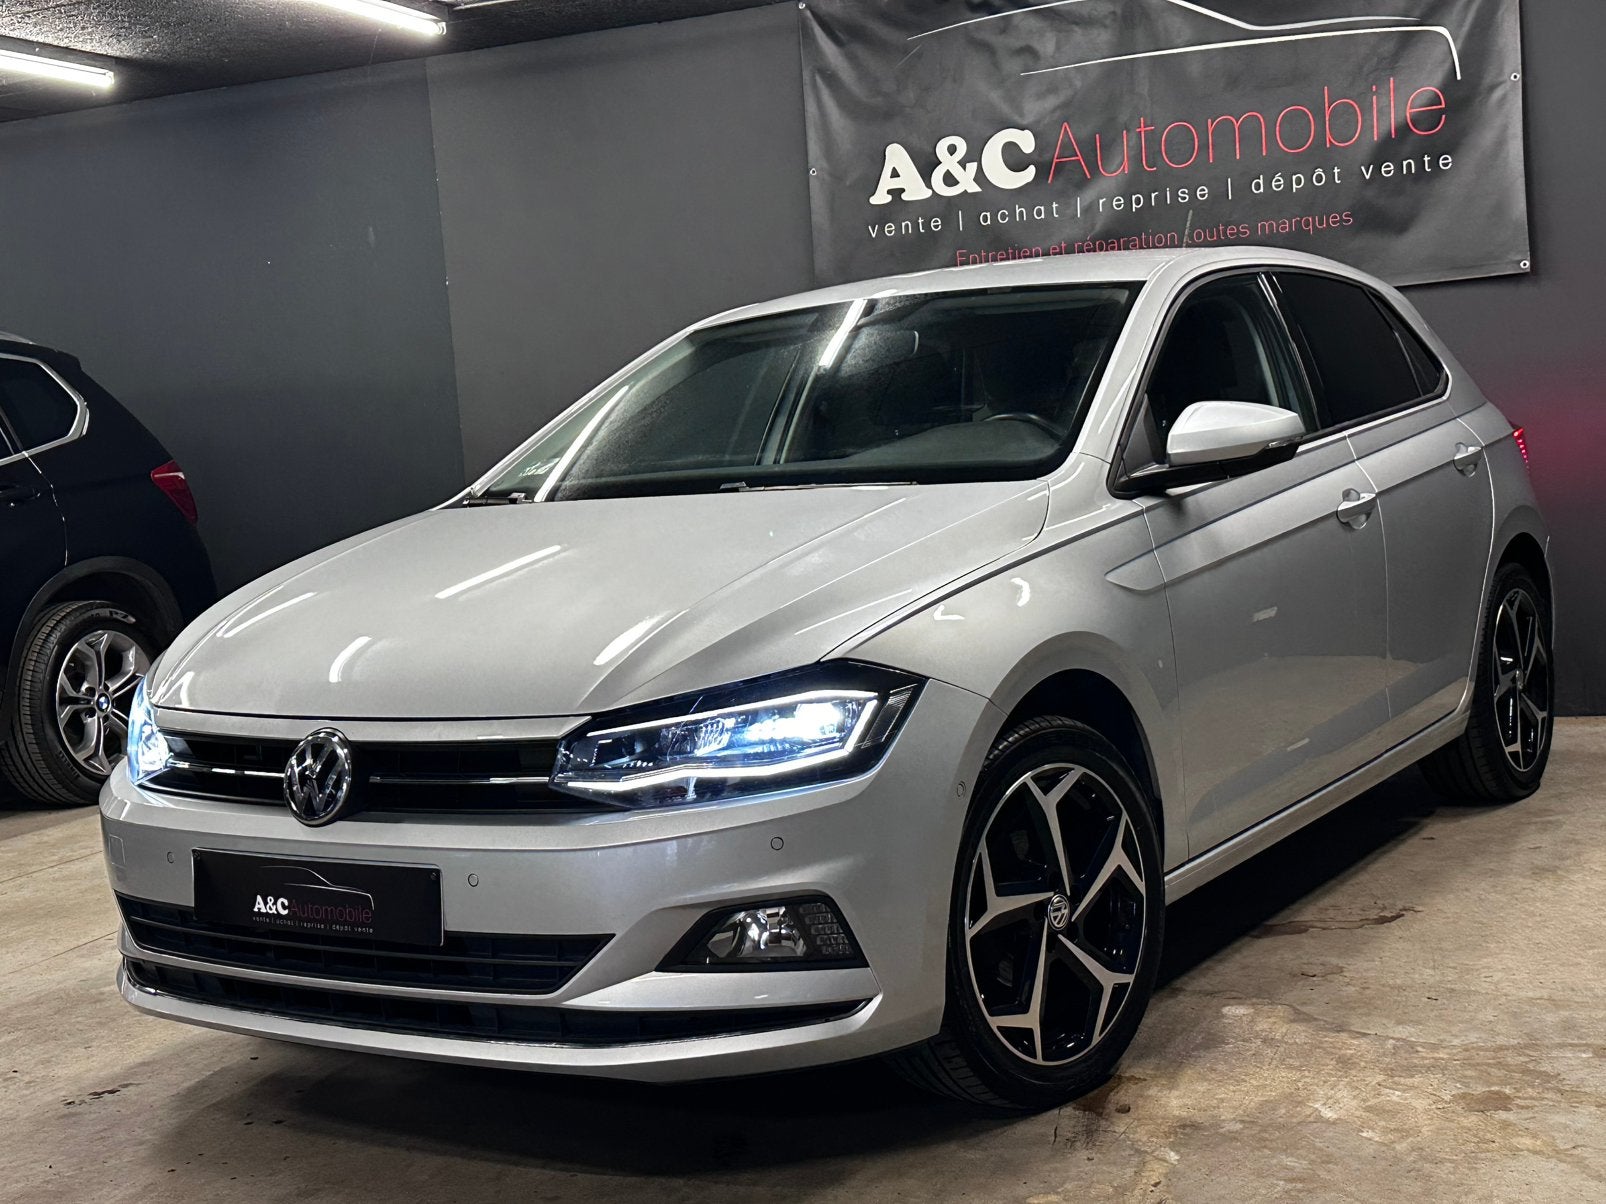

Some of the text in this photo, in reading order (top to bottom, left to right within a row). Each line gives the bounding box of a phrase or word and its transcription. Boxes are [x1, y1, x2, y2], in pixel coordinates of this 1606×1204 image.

[869, 77, 1446, 205] A&C Automobile
[868, 216, 942, 238] vente
[979, 201, 1059, 226] achat
[1099, 185, 1209, 212] reprise
[1251, 166, 1341, 193] dépôt
[1361, 154, 1453, 180] vente
[1050, 241, 1067, 256] et
[1257, 211, 1353, 235] marques
[253, 894, 372, 924] A&C Automobile
